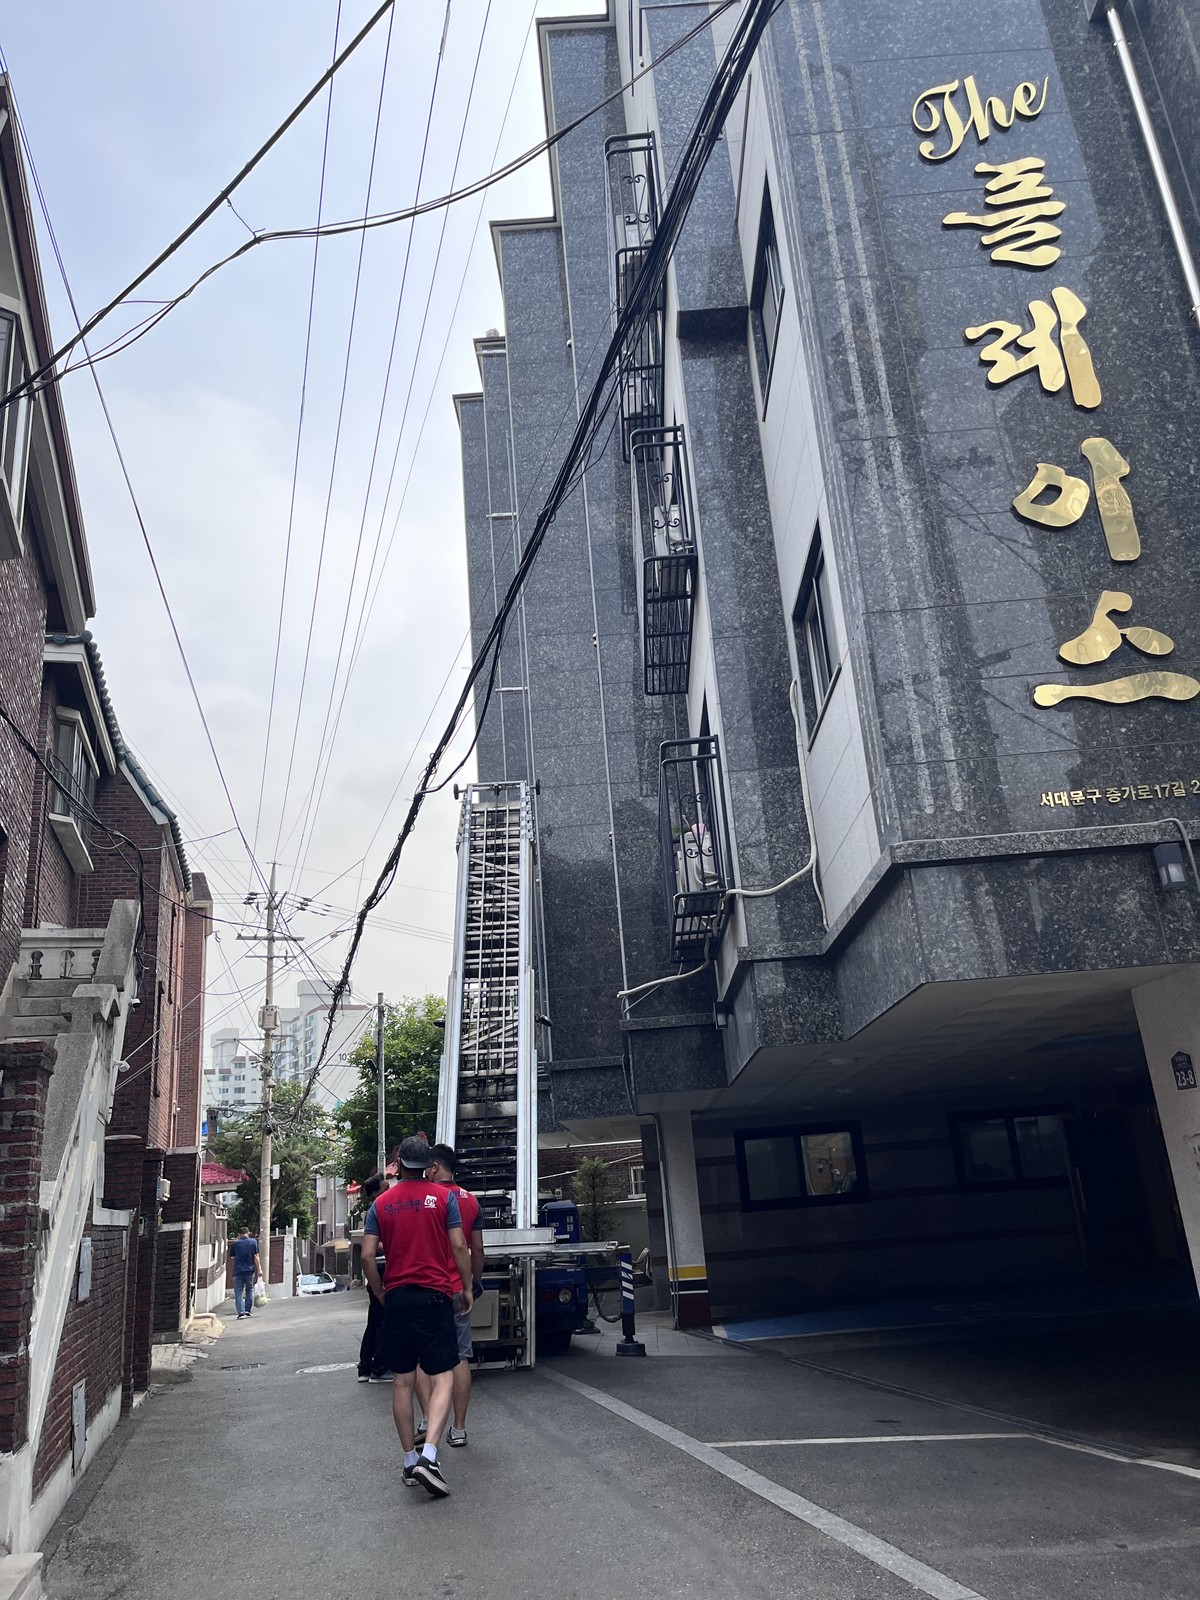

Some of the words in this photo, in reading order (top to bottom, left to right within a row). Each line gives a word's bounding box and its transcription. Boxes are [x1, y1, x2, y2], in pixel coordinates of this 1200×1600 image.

[912, 75, 1048, 160] The
[942, 156, 1200, 707] 플레이스
[1040, 788, 1102, 808] 서대문구
[1105, 780, 1186, 803] 증가로17길
[1175, 1069, 1195, 1087] 23-8
